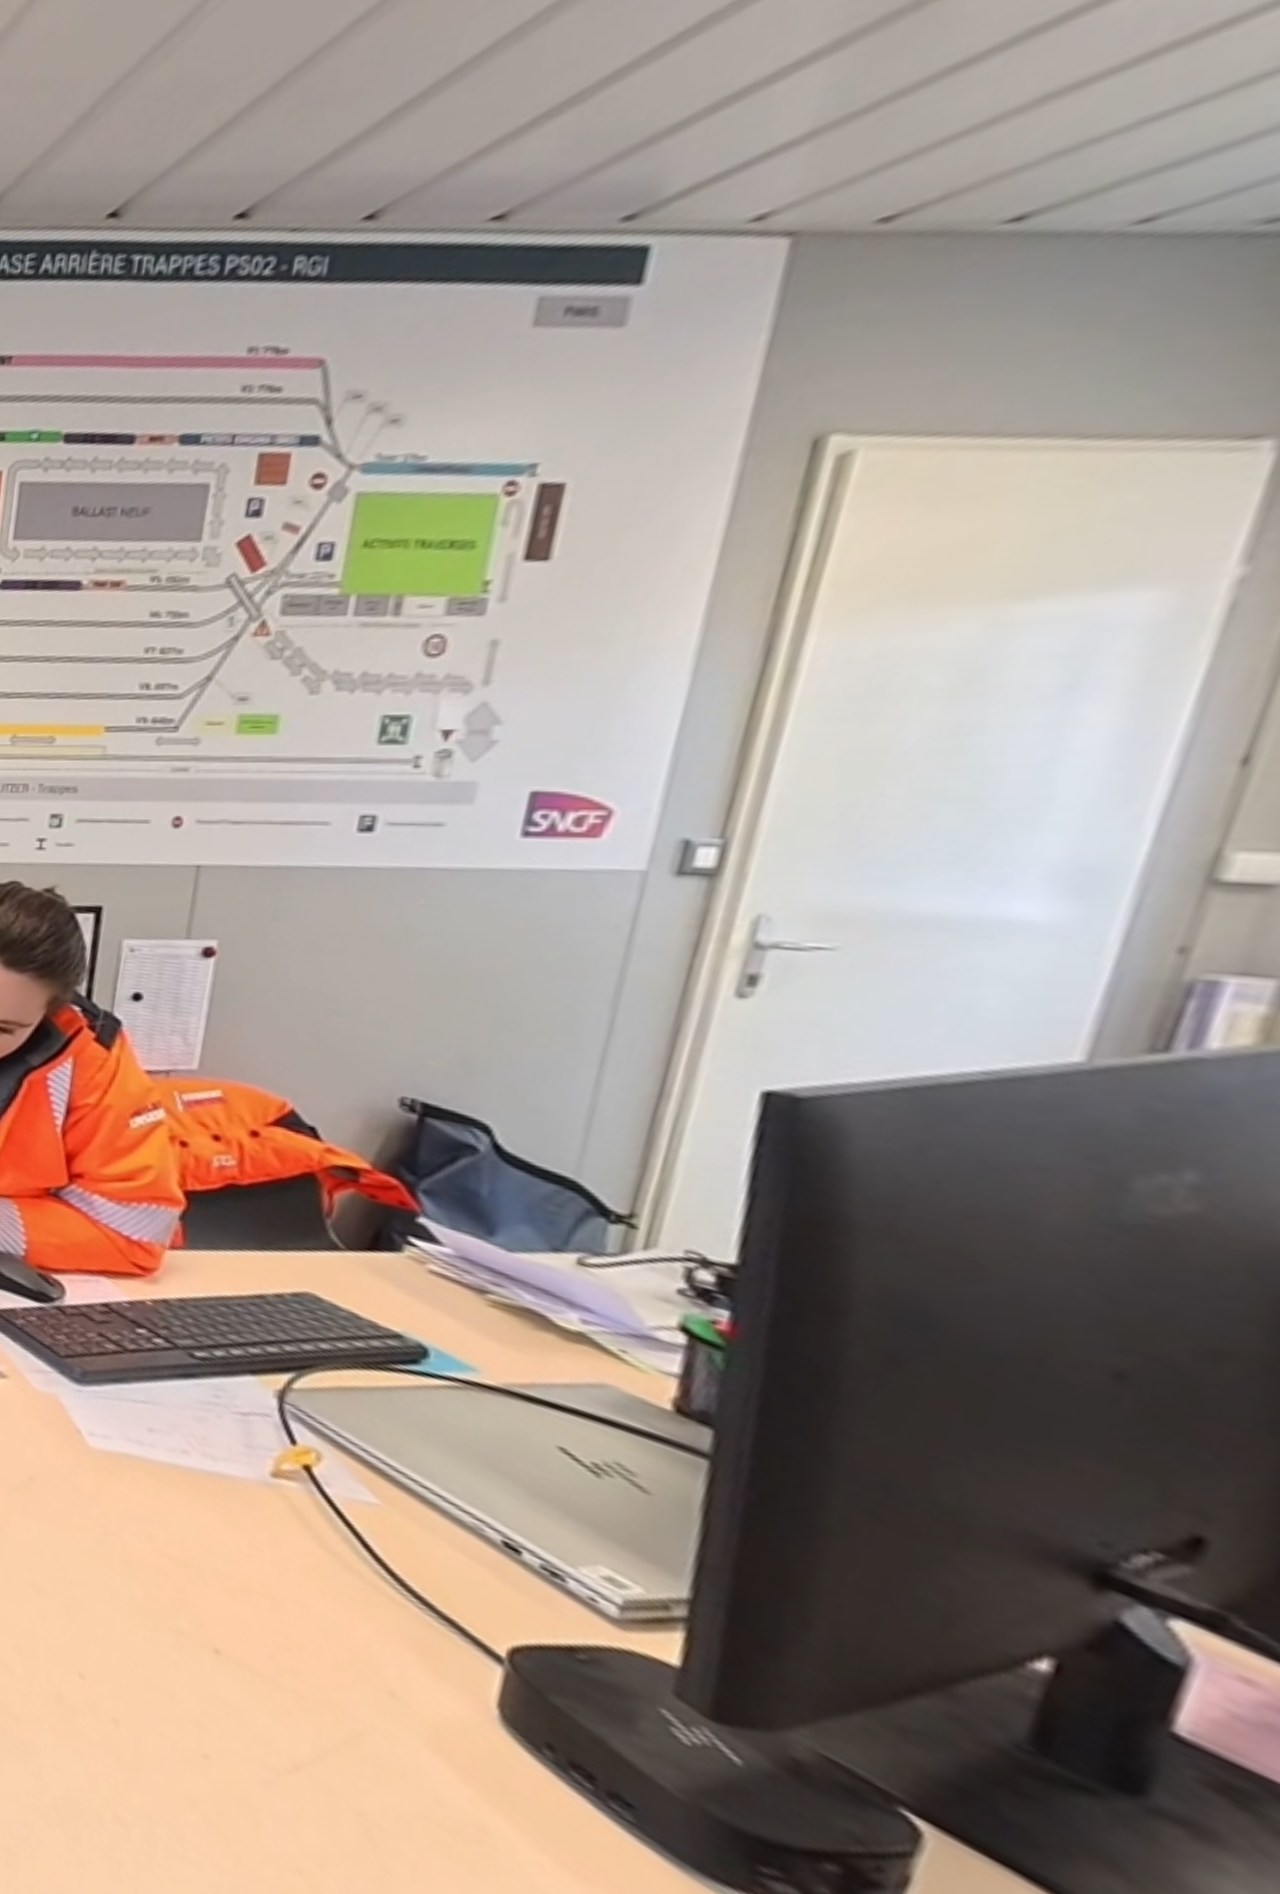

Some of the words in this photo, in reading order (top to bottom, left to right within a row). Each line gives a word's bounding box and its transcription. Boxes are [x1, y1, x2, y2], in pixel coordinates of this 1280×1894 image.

[39, 250, 126, 275] ARRIÈRE
[130, 253, 221, 276] TRAPPES
[224, 254, 277, 276] PS02
[291, 255, 330, 276] RGI
[71, 506, 117, 518] BALLAST
[525, 809, 610, 833] SNCF
